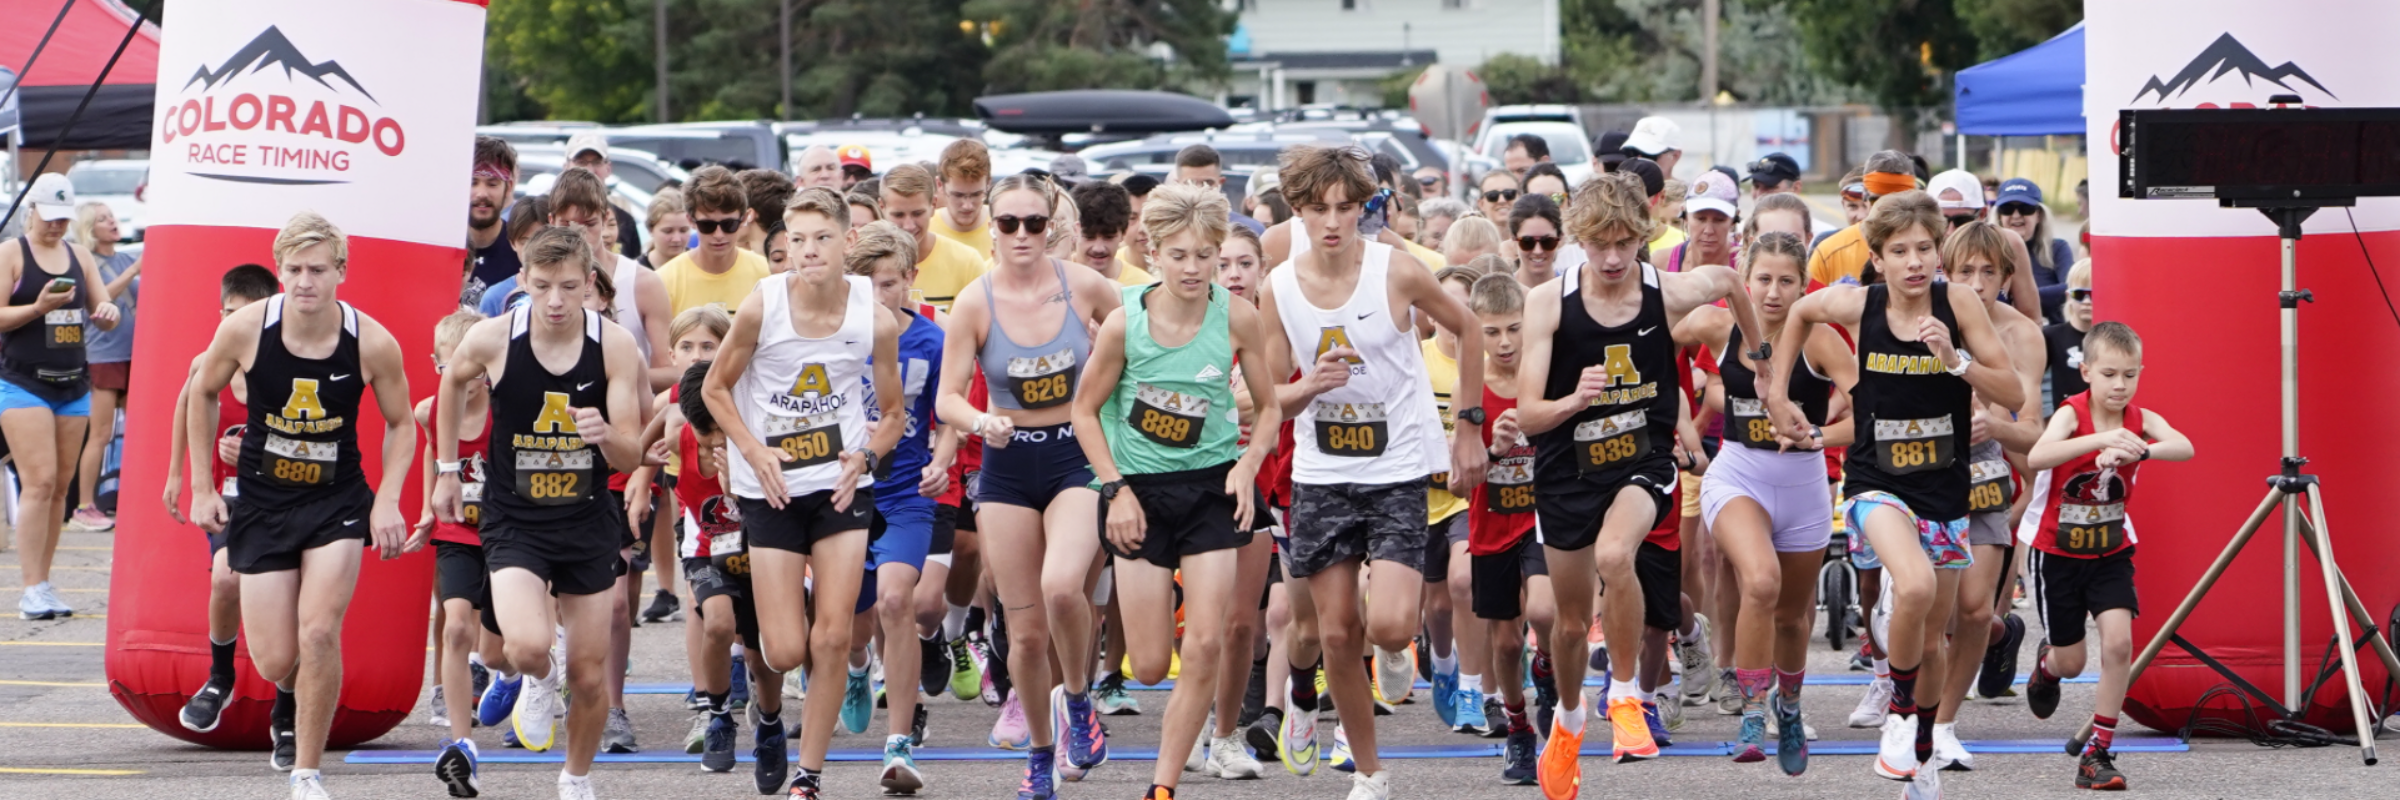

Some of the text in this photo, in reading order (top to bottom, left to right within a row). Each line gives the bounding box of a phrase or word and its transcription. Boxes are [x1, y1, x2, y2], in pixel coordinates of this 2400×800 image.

[162, 92, 405, 157] COLORADO
[187, 142, 350, 172] RACE TIMING
[55, 326, 80, 343] 969
[787, 362, 833, 398] A
[1022, 374, 1068, 403] 826
[282, 378, 326, 419] A
[532, 391, 577, 434] A
[769, 391, 847, 414] ARAPAHOE
[1141, 409, 1190, 441] 889
[1328, 425, 1375, 451] 840
[781, 431, 831, 463] 850
[1589, 434, 1637, 466] 938
[1891, 440, 1937, 468] 881
[274, 458, 321, 484] 880
[530, 472, 578, 498] 882
[2069, 525, 2109, 549] 911
